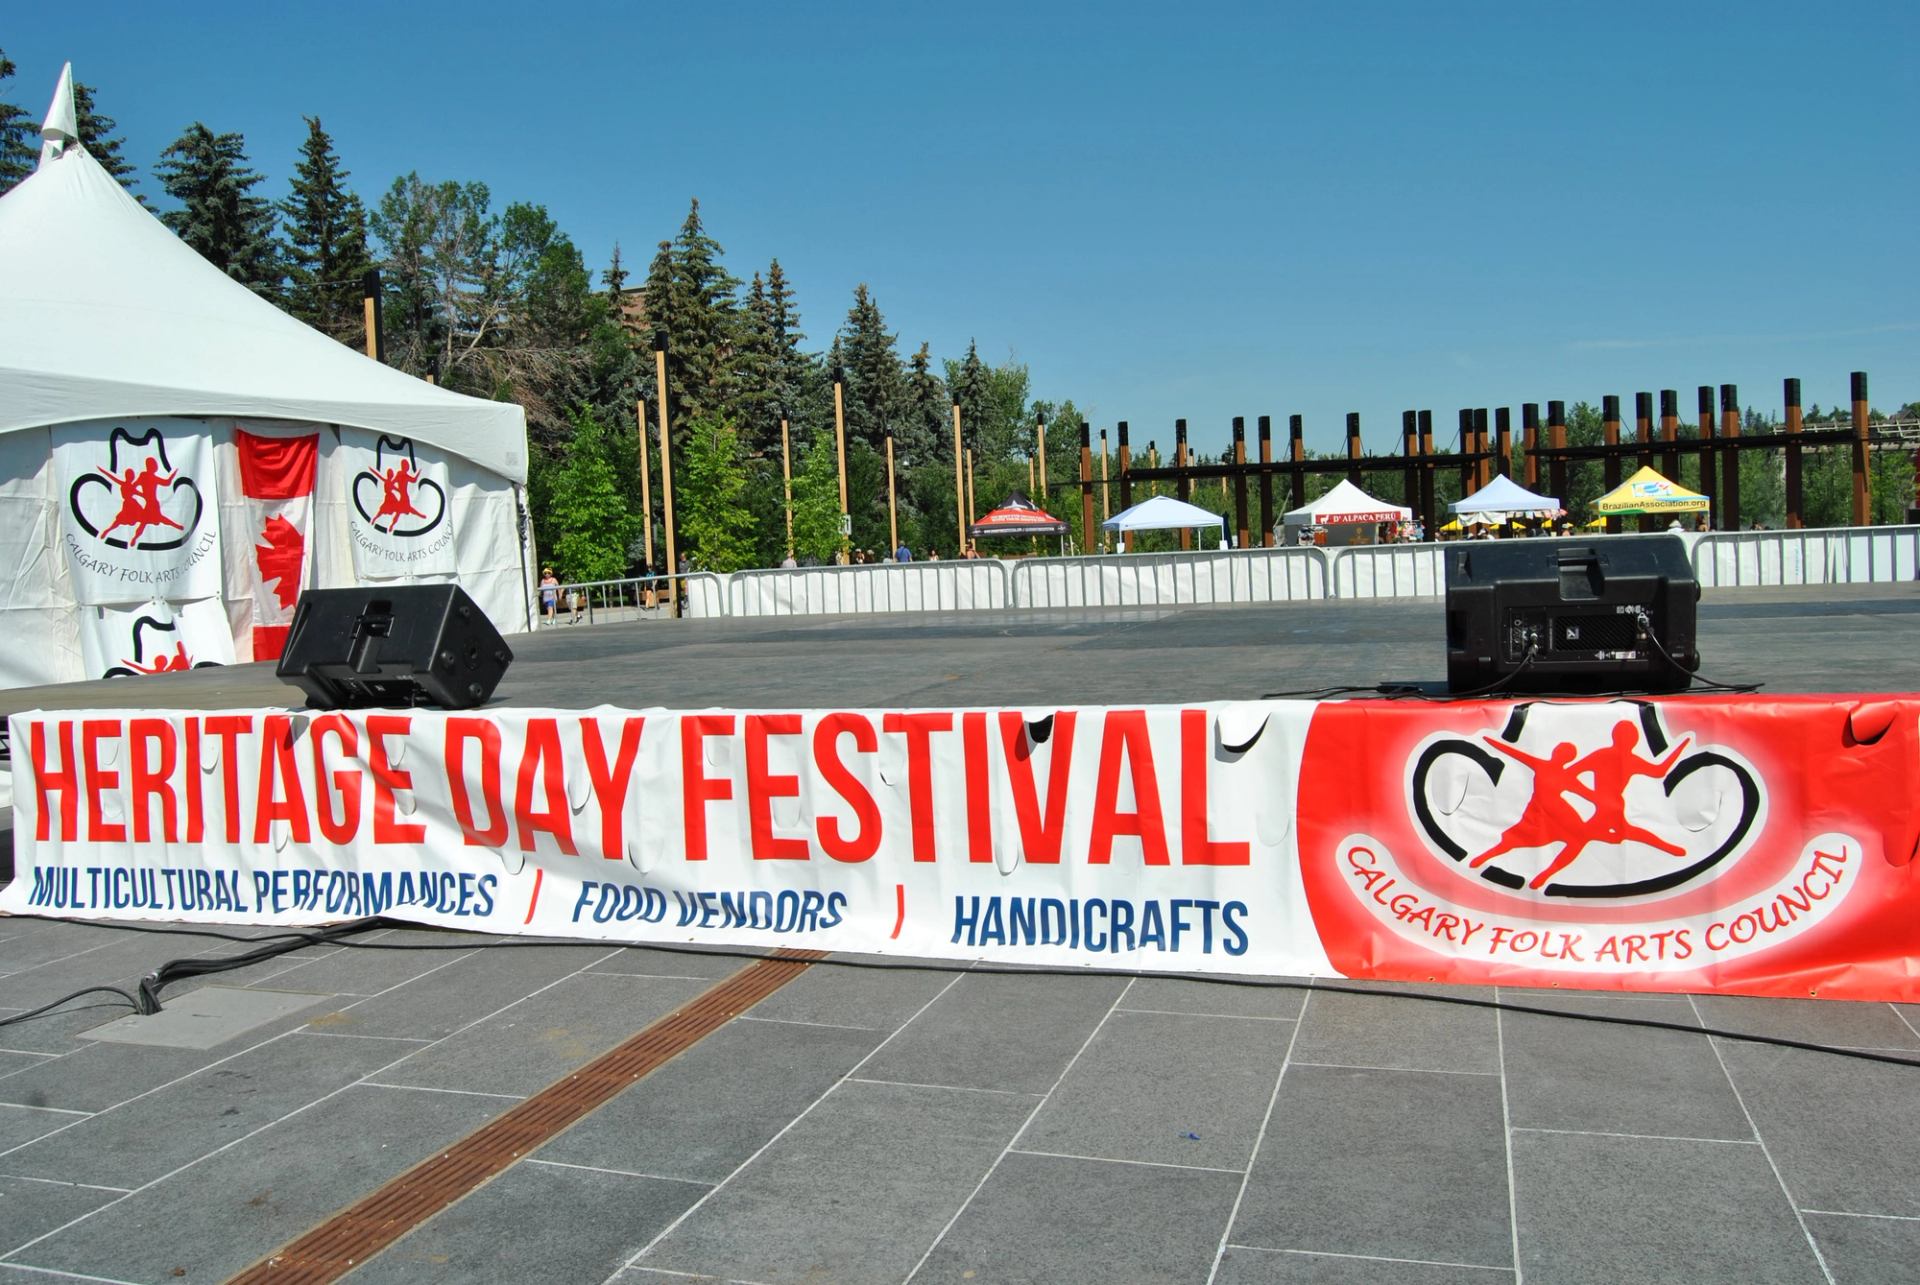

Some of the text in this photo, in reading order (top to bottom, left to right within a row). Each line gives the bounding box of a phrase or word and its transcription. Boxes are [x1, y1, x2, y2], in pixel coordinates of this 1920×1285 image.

[1343, 514, 1374, 522] ALPACA
[1602, 500, 1706, 510] BrazilianAssociation.org
[66, 533, 119, 577] CALGARY
[119, 568, 154, 584] FOLK
[155, 566, 180, 583] ARTS
[350, 521, 384, 556] CALGARY
[407, 549, 427, 561] ARTS
[30, 710, 1251, 866] HERITAGE DAY FESTIVAL
[28, 865, 1250, 956] MULTICULTURAL PERFORMANCES FOOD VENDORS HANDICRAFTS
[1346, 844, 1849, 964] CALGARY FOLK ARTS COUNCIL
